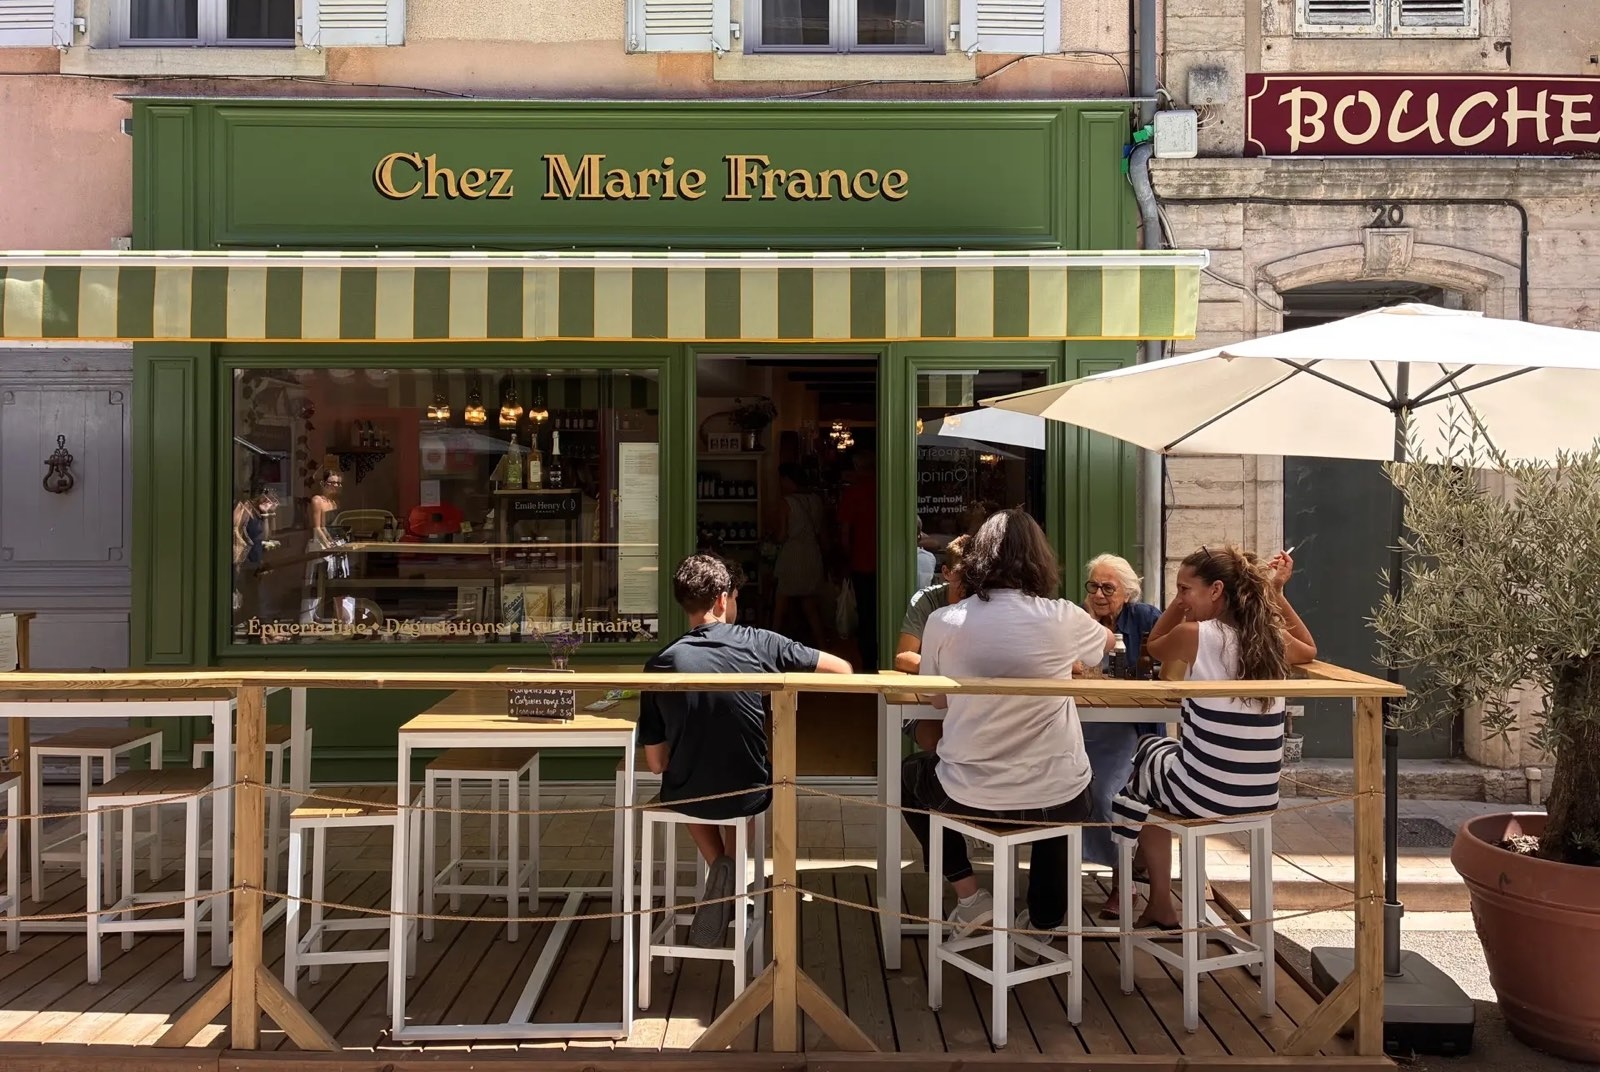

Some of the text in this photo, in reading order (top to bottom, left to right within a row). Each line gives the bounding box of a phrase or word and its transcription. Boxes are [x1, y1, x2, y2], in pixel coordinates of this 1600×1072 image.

[1277, 85, 1600, 154] BOUCHE
[372, 152, 910, 202] Chez Marie France
[1369, 204, 1404, 228] 20
[514, 501, 561, 511] Emile Henry
[248, 616, 325, 641] Épicerie
[385, 618, 505, 637] Dégustations
